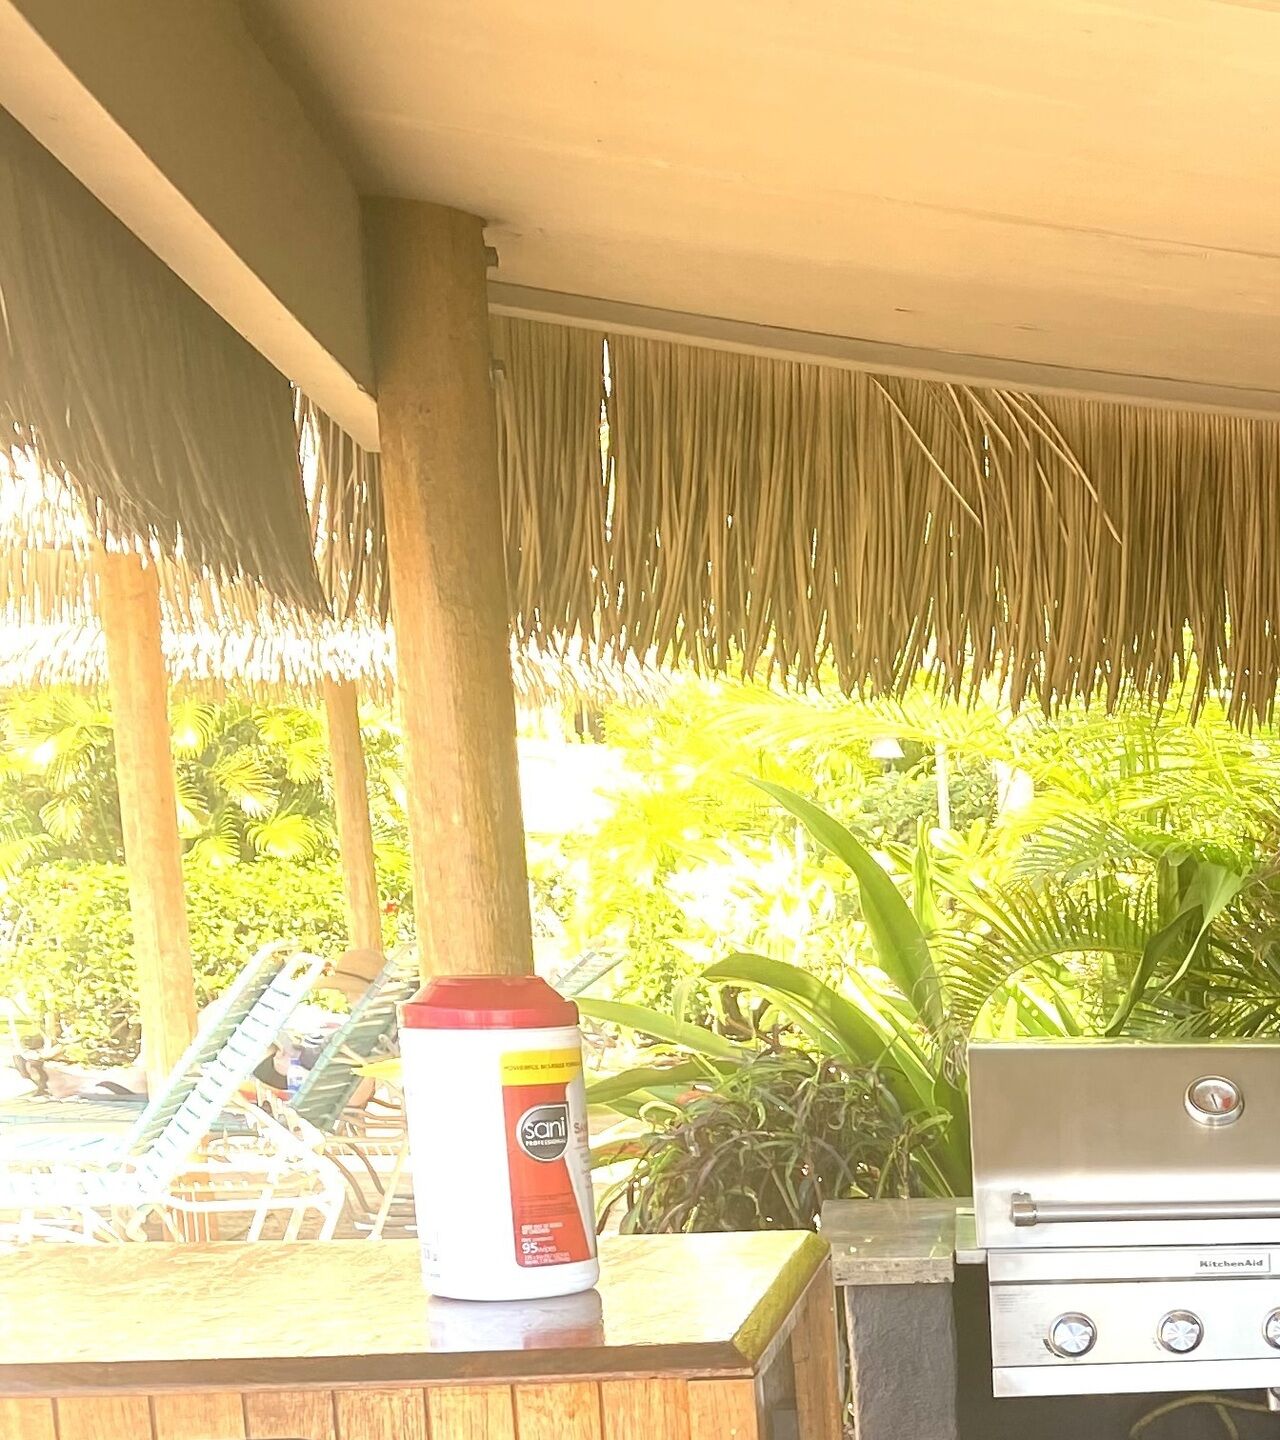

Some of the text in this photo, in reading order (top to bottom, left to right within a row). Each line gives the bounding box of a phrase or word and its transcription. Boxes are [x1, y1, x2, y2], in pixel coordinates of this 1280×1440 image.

[523, 1116, 566, 1140] sani
[521, 1242, 538, 1254] 95
[1199, 1259, 1264, 1268] KitchenAid
